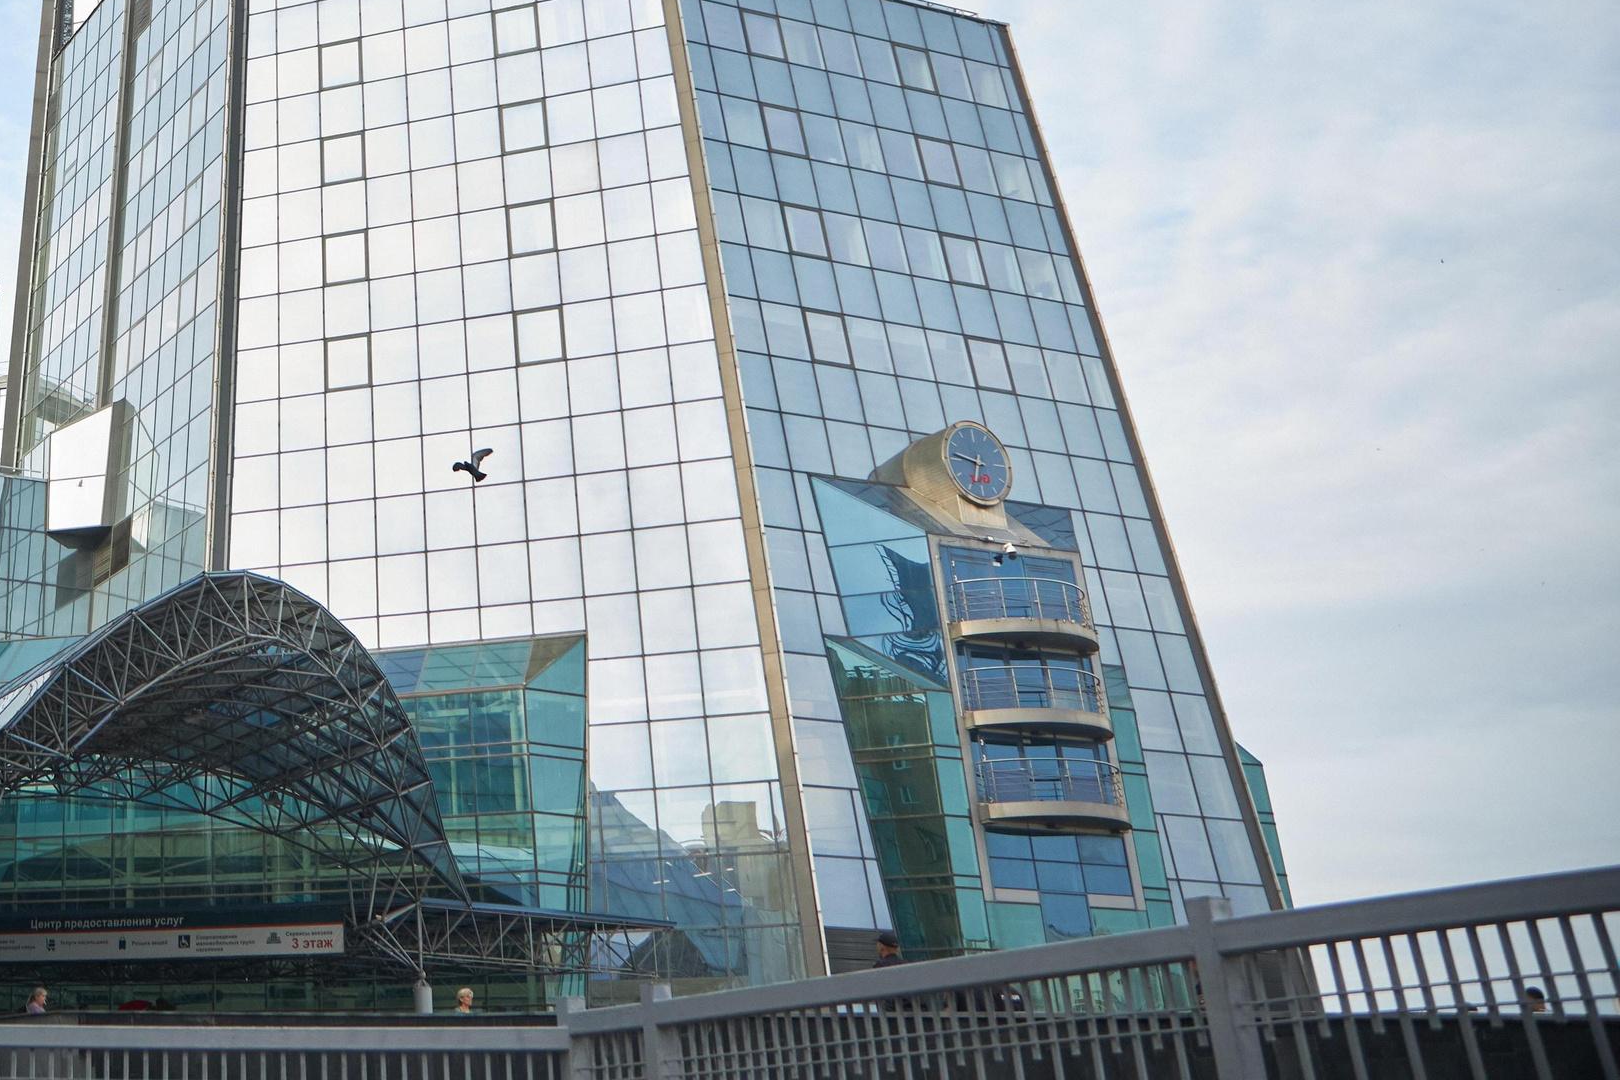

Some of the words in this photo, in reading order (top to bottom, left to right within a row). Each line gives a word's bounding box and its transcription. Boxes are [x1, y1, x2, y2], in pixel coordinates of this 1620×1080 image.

[30, 919, 62, 931] Центр
[65, 918, 151, 929] предоставления
[155, 916, 184, 927] услуг
[292, 937, 299, 949] 3
[303, 939, 333, 949] этаж
